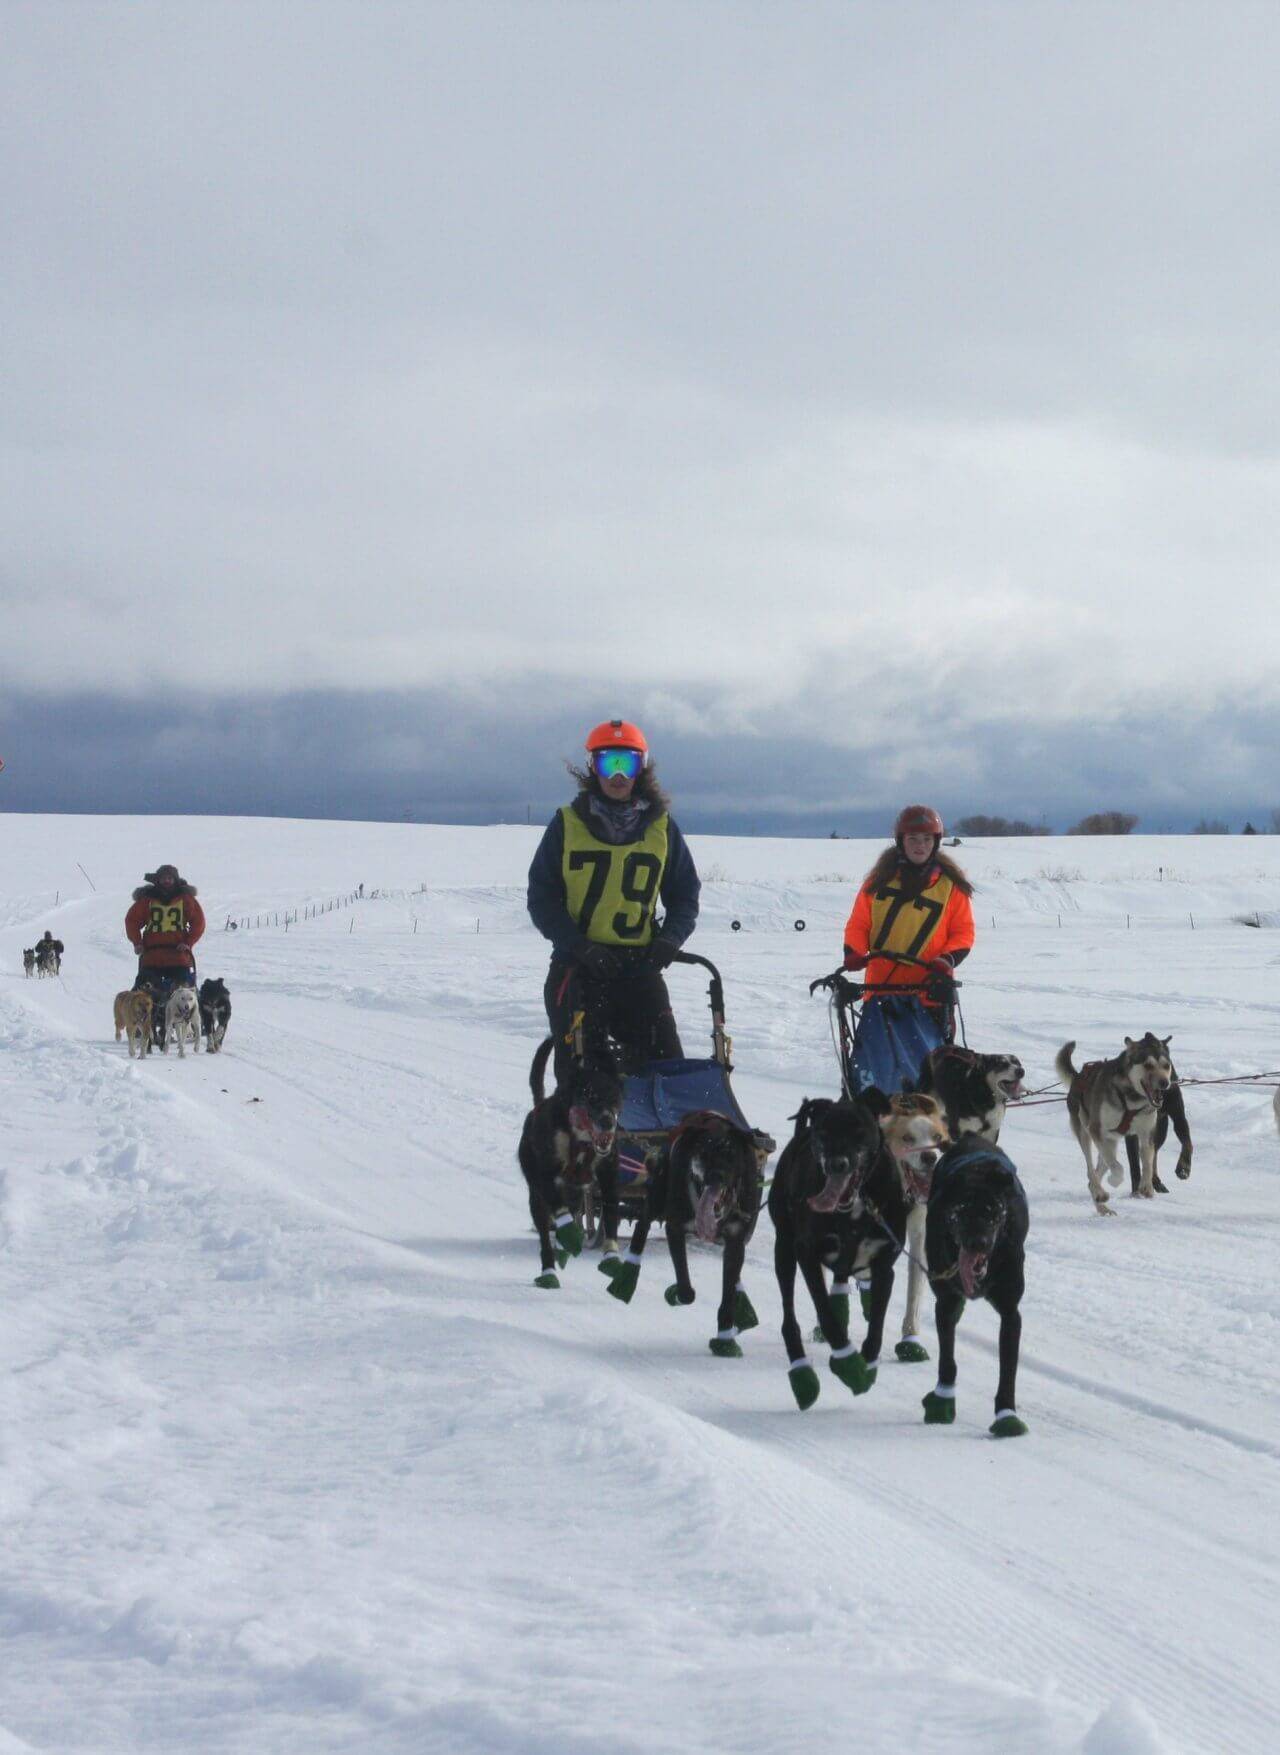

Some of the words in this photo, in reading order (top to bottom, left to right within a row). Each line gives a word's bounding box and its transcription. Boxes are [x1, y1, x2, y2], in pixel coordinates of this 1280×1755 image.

[151, 907, 181, 933] 83
[569, 851, 661, 939] 79
[876, 886, 943, 957] 77
